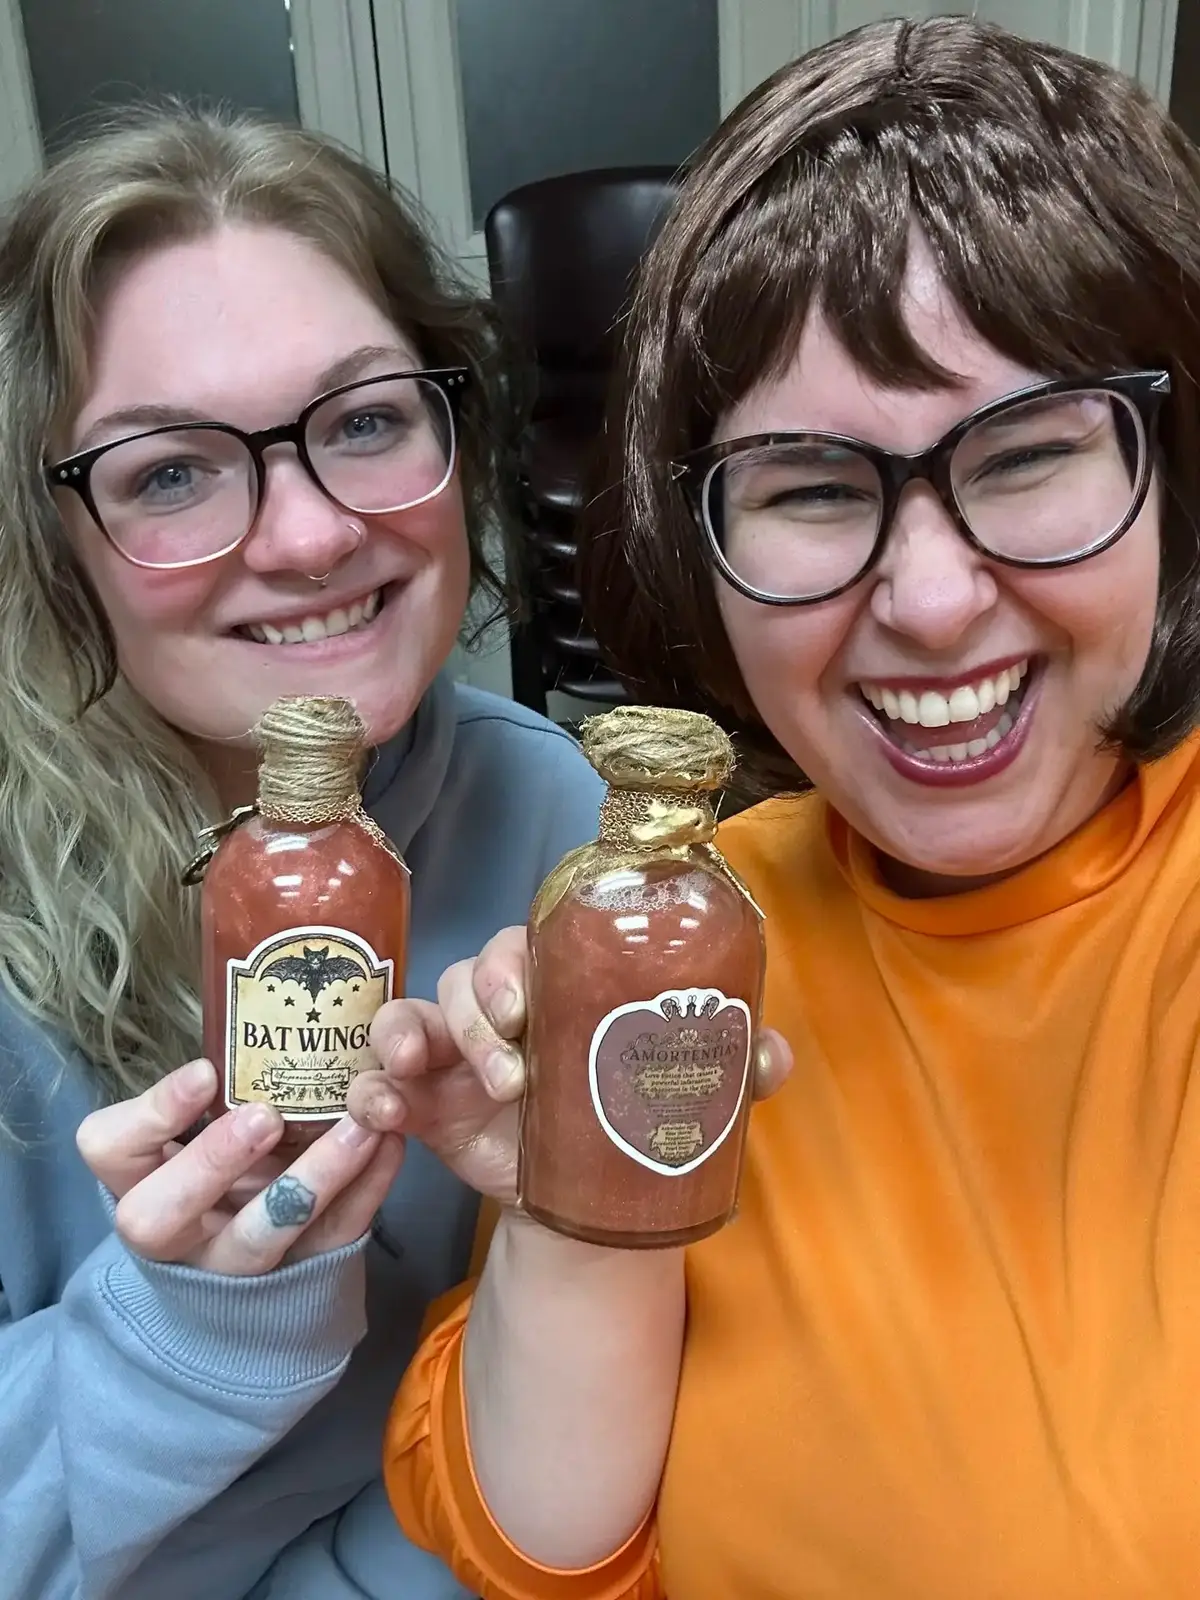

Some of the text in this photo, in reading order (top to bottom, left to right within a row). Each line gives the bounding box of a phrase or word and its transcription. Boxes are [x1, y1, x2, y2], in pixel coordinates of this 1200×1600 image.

[244, 1021, 292, 1051] BAT
[630, 1045, 732, 1062] AMORTENTIA
[274, 1070, 347, 1082] Superior Quality
